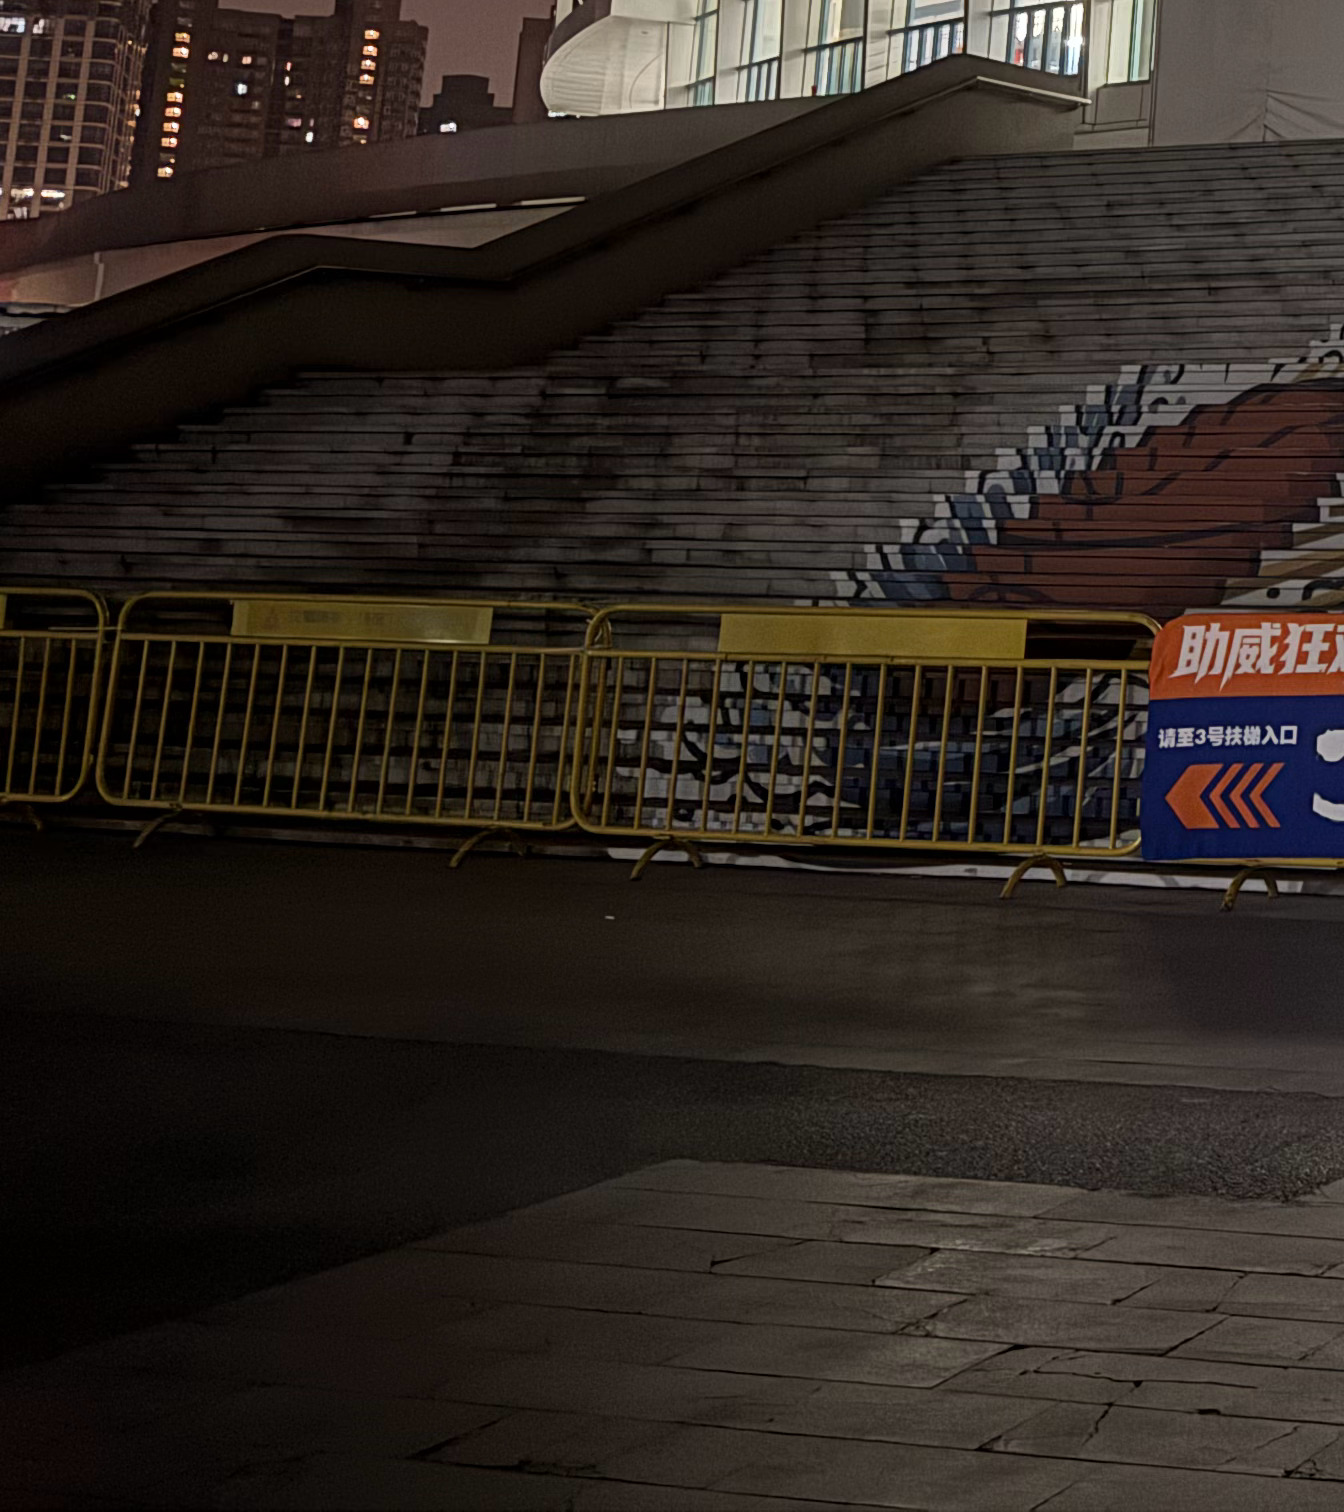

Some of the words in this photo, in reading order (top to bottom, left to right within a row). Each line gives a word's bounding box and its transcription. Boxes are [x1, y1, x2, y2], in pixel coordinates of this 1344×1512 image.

[1158, 725, 1298, 749] 请至3号扶梯入口
